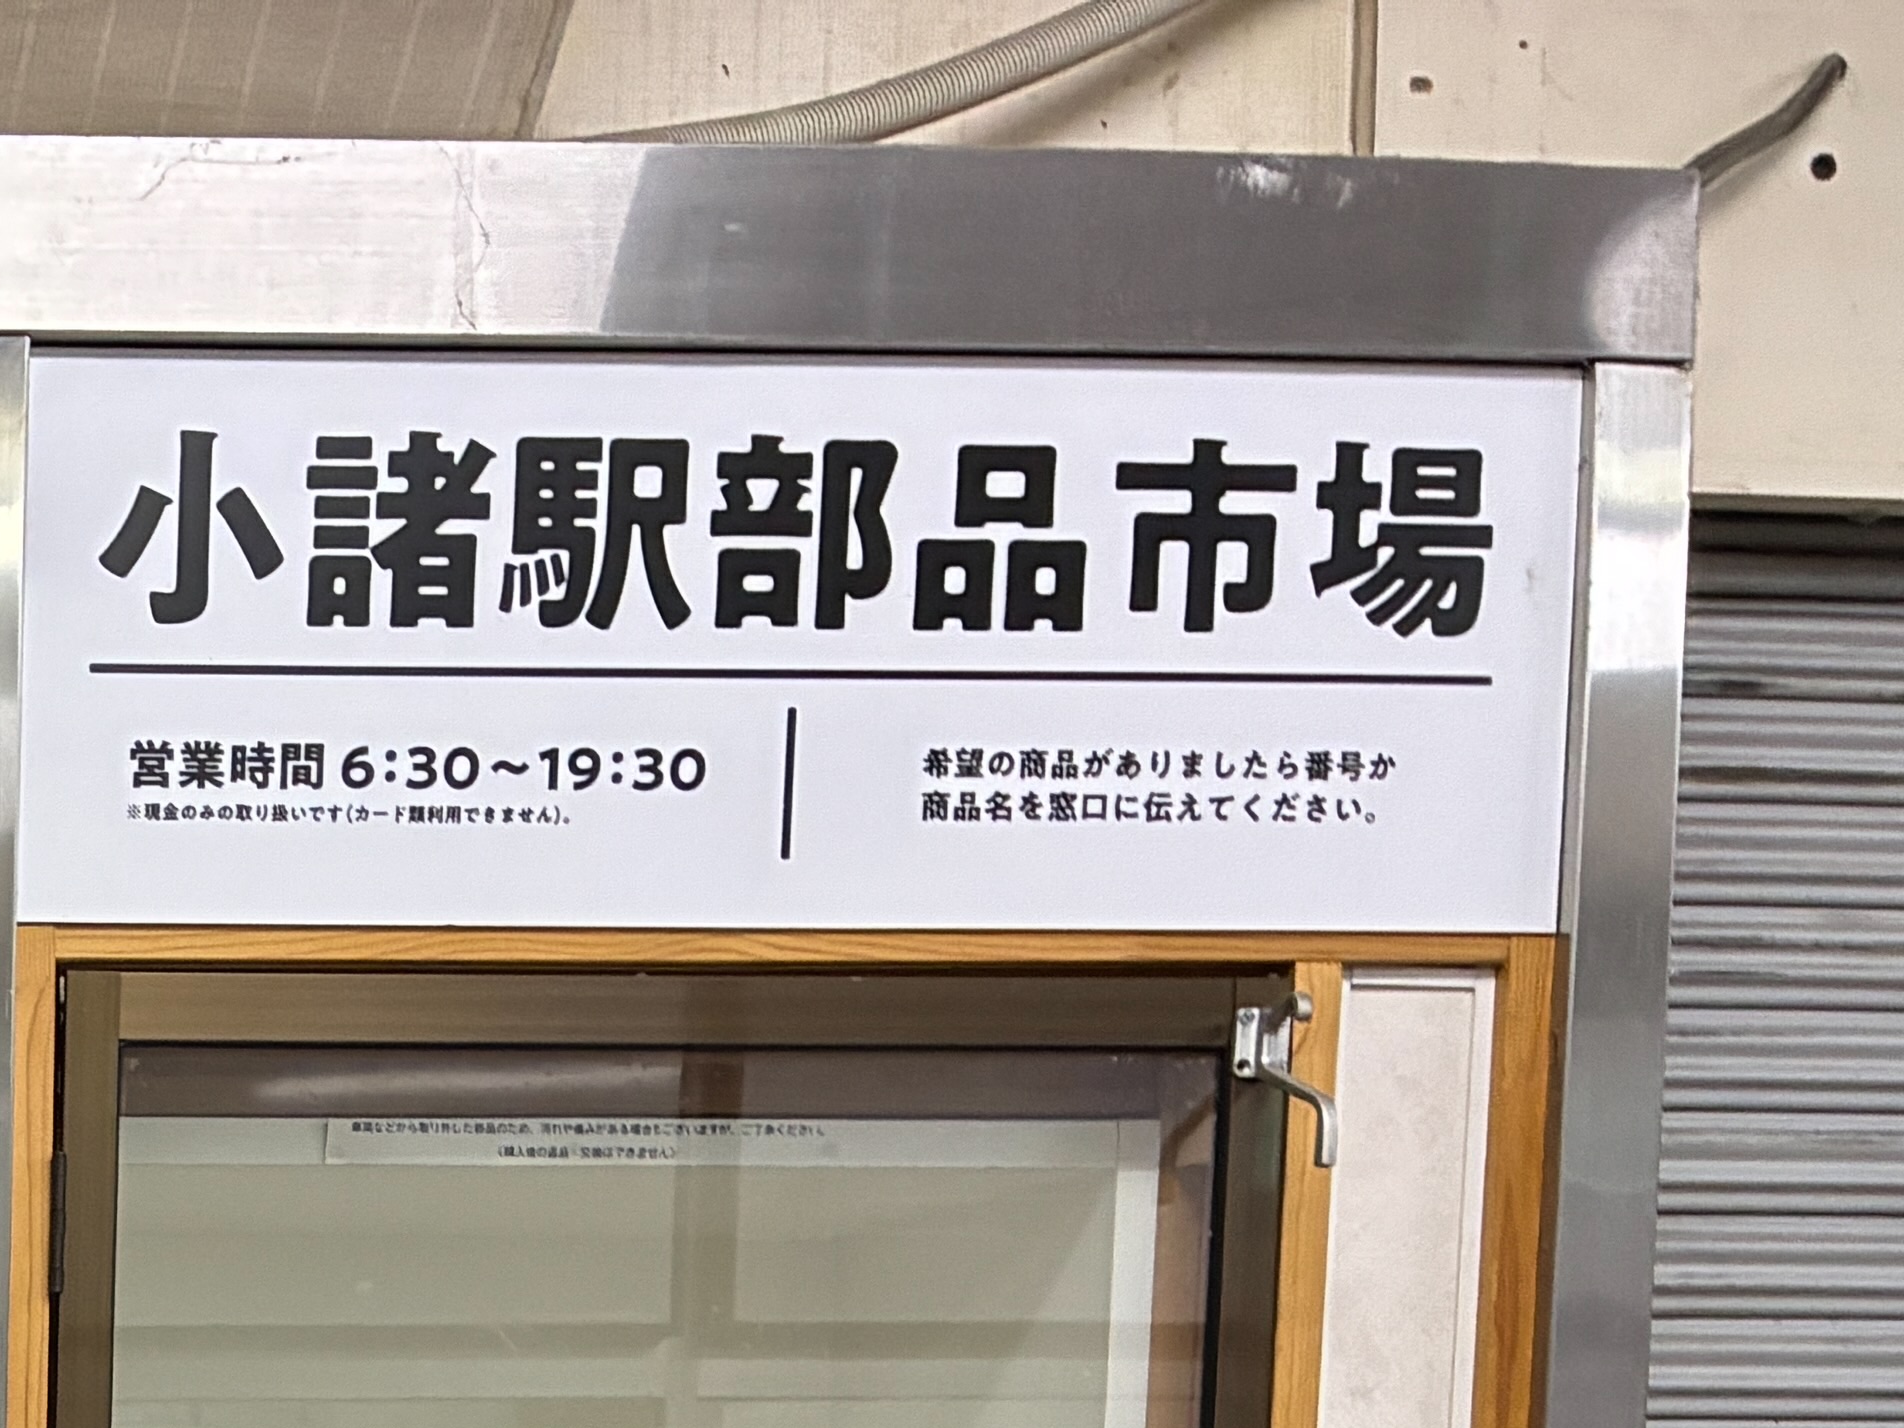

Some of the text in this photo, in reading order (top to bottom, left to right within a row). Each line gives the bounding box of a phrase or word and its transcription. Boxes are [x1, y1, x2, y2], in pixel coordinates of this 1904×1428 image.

[98, 430, 1492, 636] 小諸駅部品市場
[127, 741, 326, 790] 営業時間
[921, 747, 1396, 783] 希望の商品がありましたら番号か
[921, 790, 1385, 827] 商品名を窓口に伝えてください。
